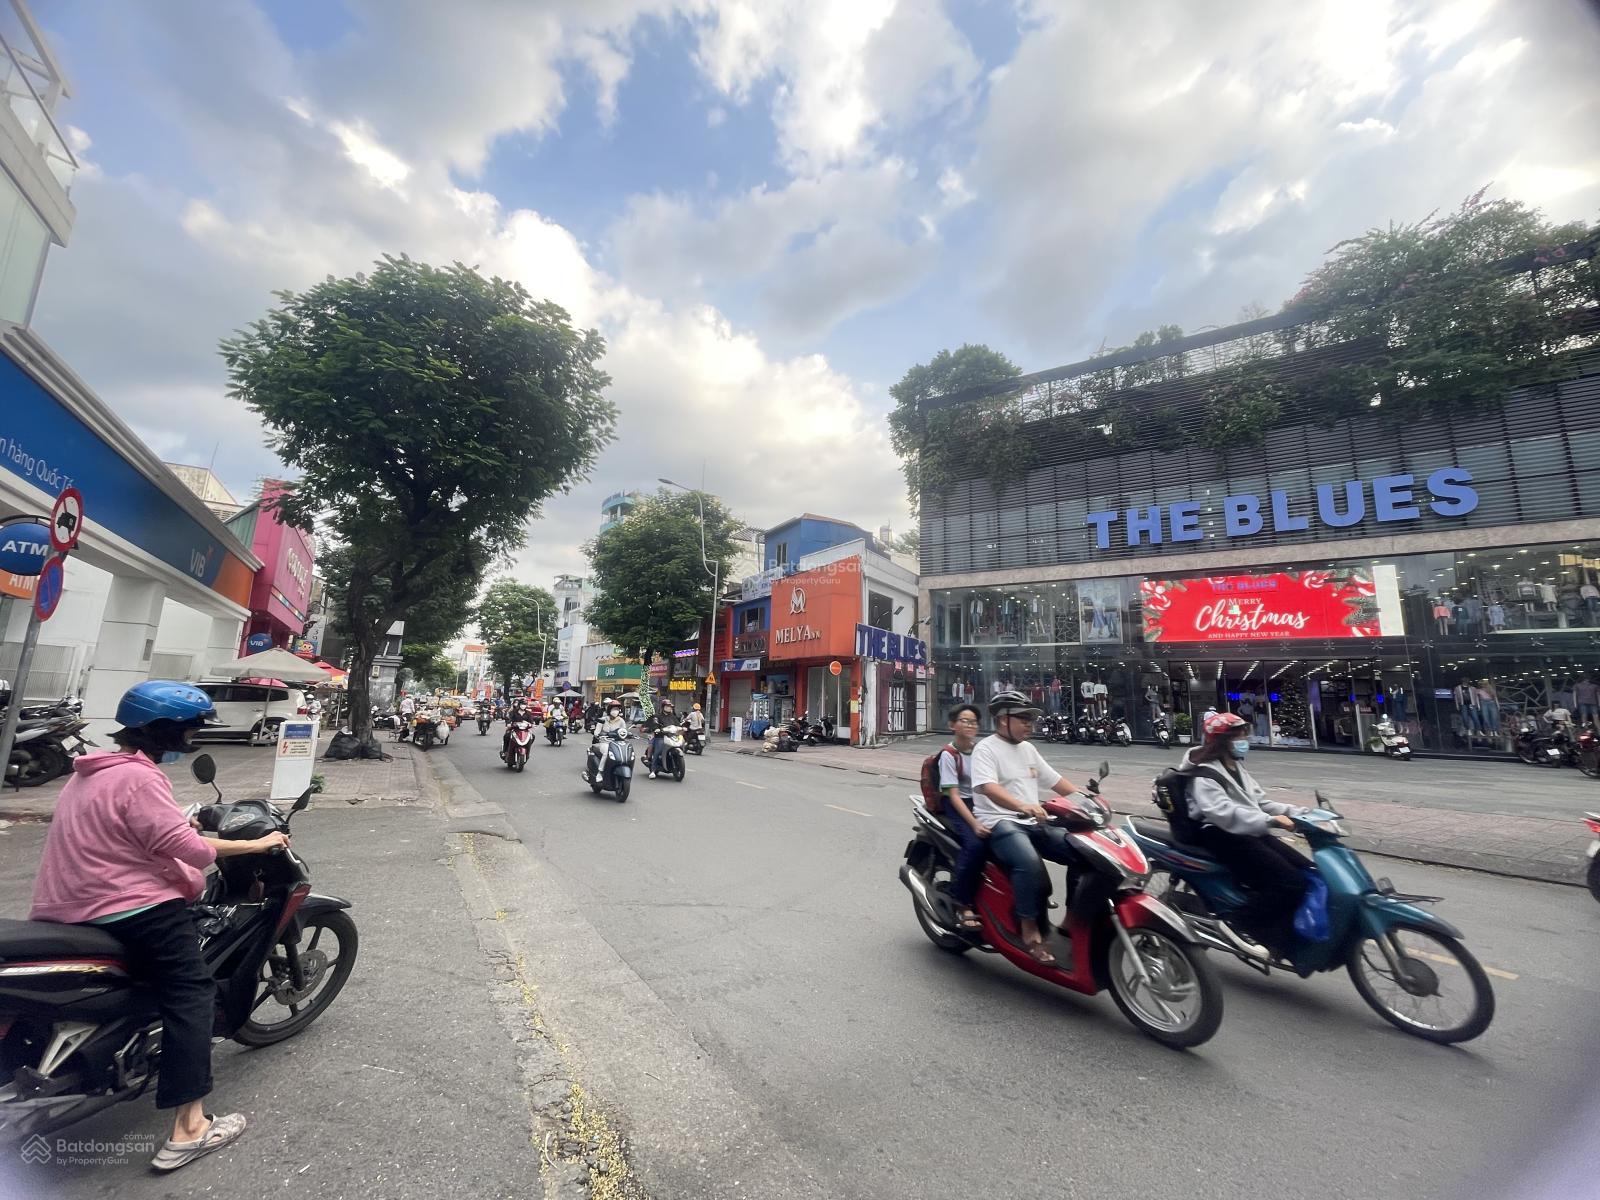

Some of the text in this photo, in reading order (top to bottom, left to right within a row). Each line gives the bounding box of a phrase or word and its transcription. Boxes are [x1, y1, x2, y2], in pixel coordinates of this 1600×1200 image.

[8, 438, 35, 476] hàng
[36, 459, 62, 489] Quốc
[1087, 467, 1479, 549] THE BLUES
[2, 540, 48, 556] ATM
[190, 548, 206, 578] VIB
[9, 574, 34, 591] ATM
[1195, 599, 1310, 632] Christmas
